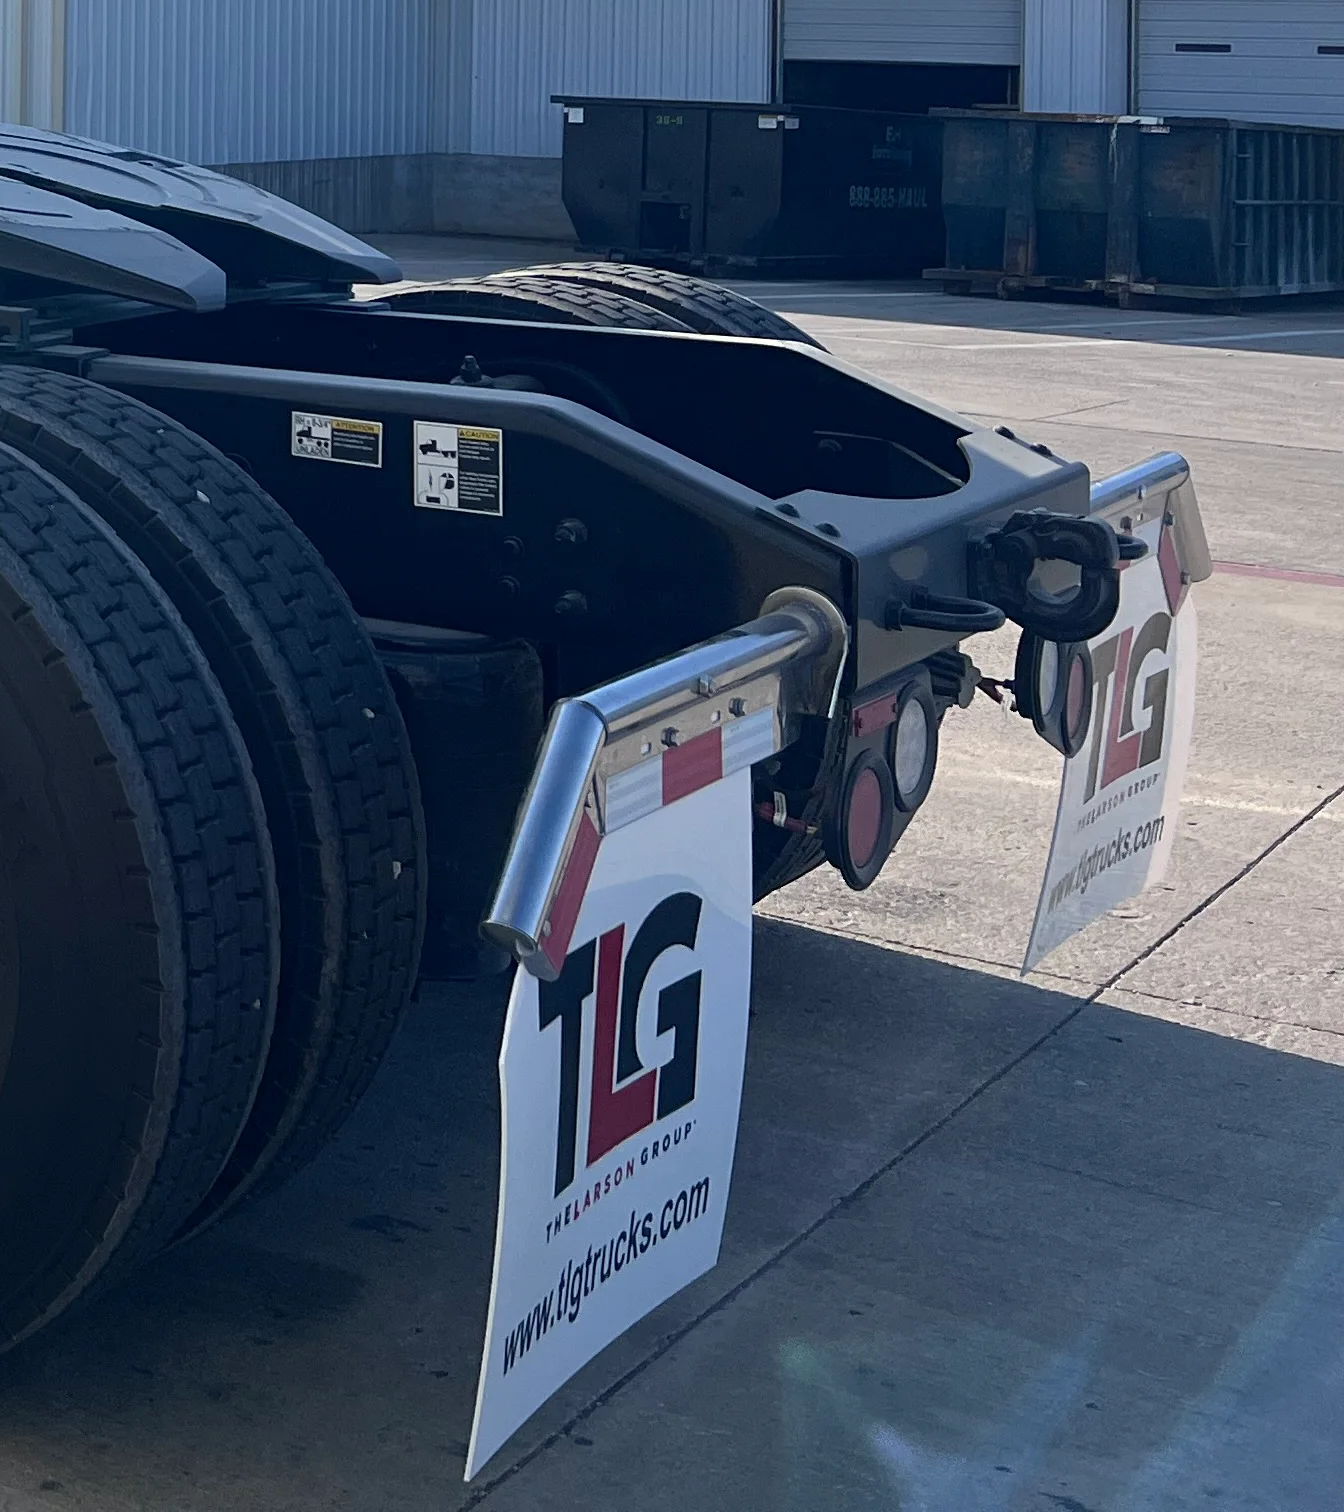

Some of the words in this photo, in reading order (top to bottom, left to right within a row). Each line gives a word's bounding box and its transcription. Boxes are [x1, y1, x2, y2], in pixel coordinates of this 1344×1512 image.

[335, 421, 375, 432] ATTENTION
[465, 430, 499, 440] CAUTION
[1083, 611, 1172, 805] TLG
[1048, 815, 1165, 915] www.tlgtrucks.com
[539, 892, 702, 1197] TLG
[640, 1124, 693, 1166] GROUP
[503, 1176, 710, 1376] www.tlgtrucks.com
